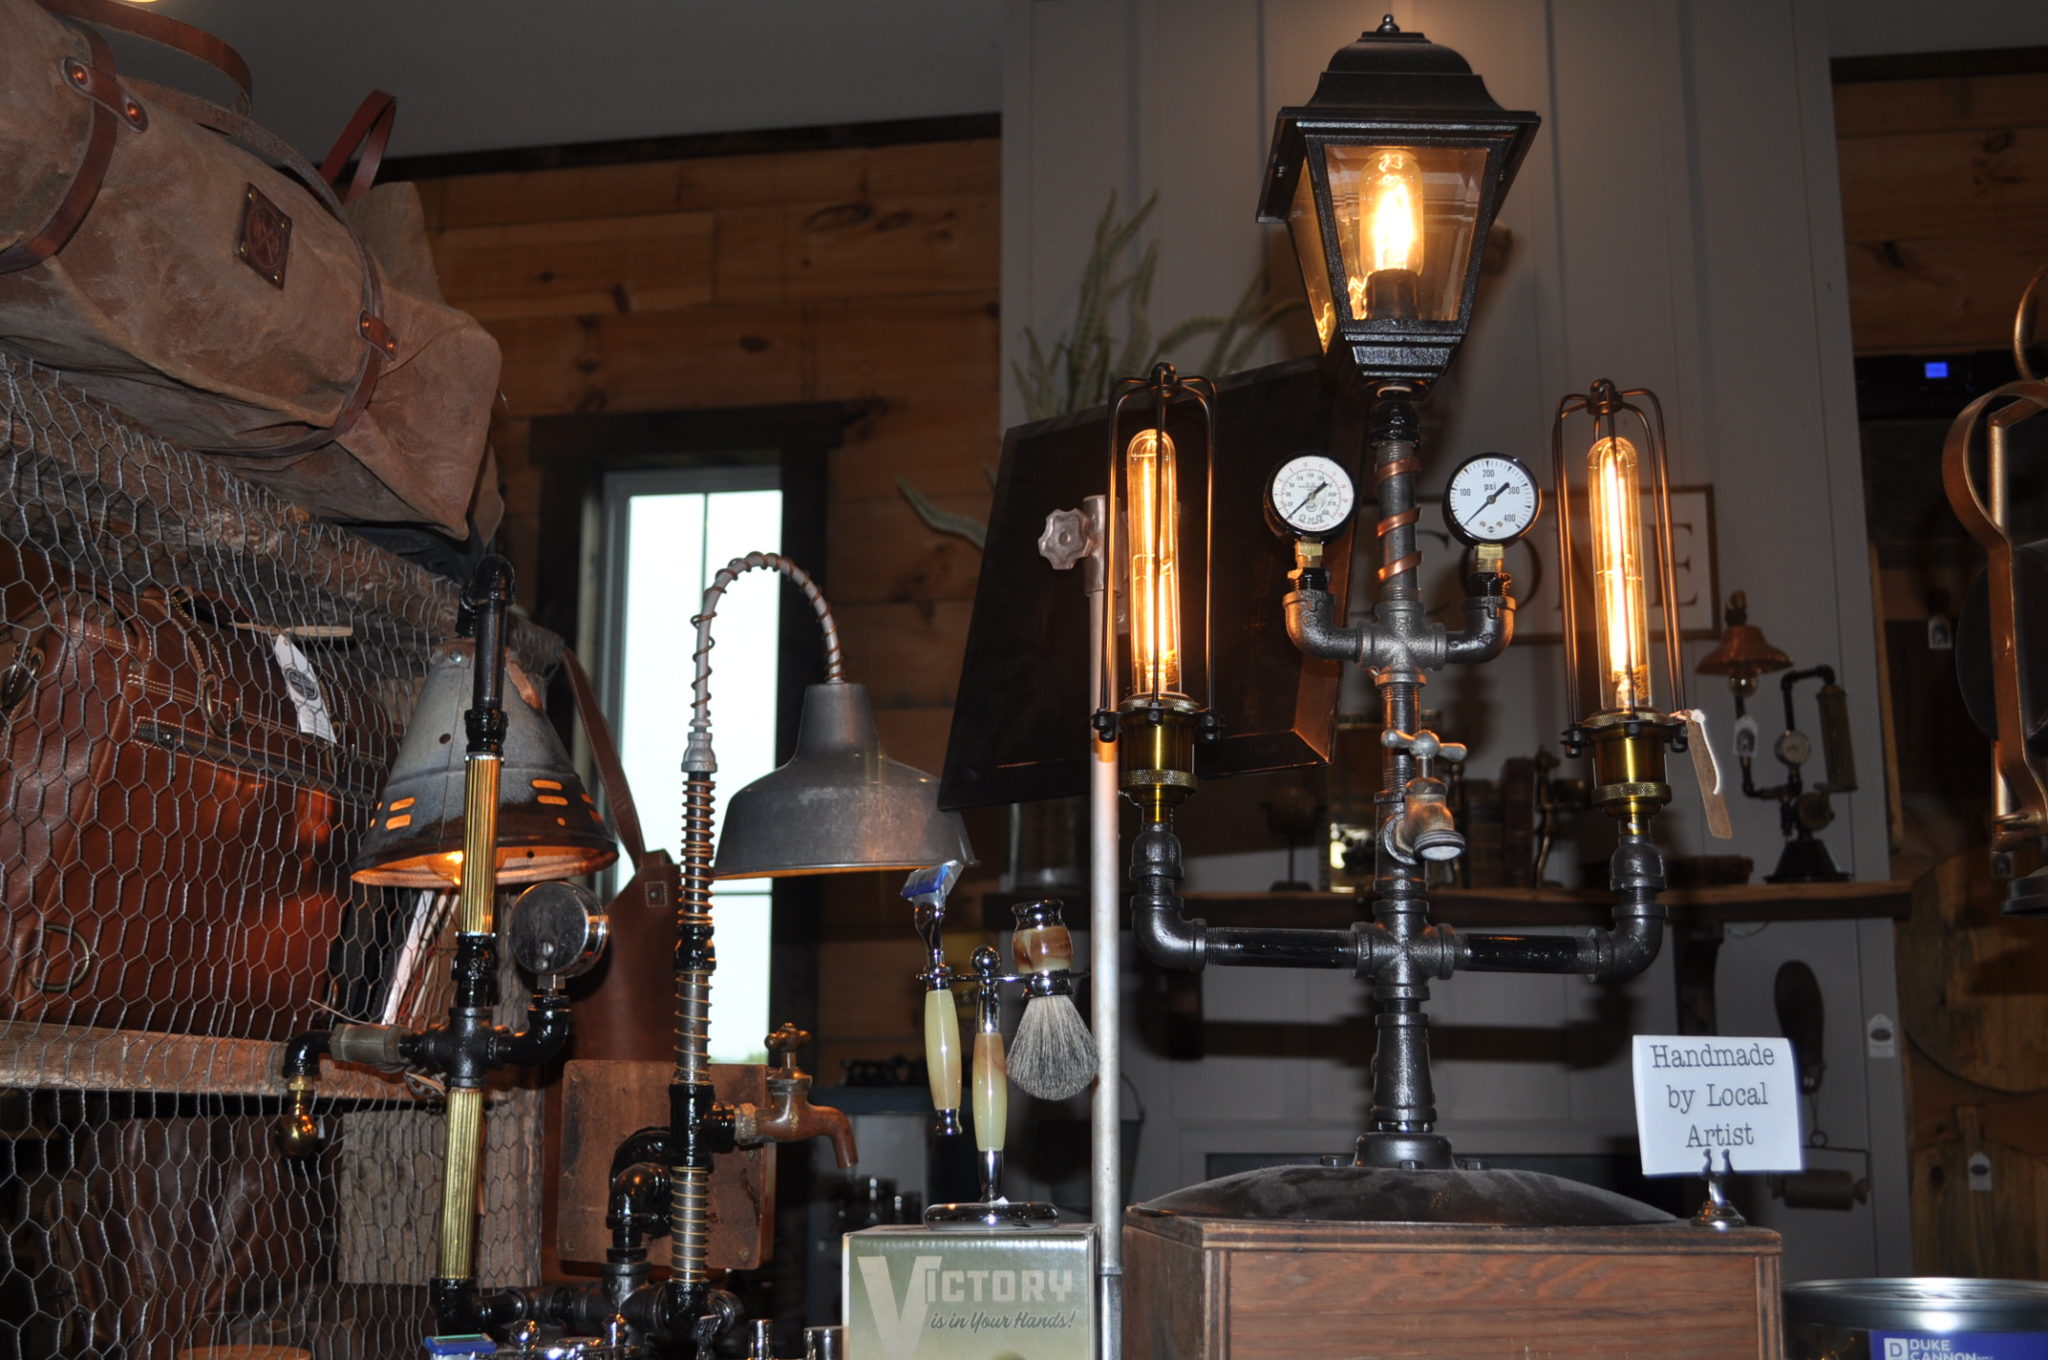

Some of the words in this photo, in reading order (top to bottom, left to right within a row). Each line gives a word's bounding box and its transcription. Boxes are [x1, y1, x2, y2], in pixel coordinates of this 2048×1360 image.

[1482, 469, 1495, 478] 200
[1484, 482, 1497, 491] psi
[1508, 487, 1520, 495] 300
[1460, 488, 1471, 497] 100
[1504, 514, 1516, 522] 400
[1650, 1043, 1775, 1068] Handmade
[1666, 1084, 1696, 1114] by
[1706, 1082, 1768, 1107] Local
[1685, 1122, 1754, 1148] Artist
[857, 1255, 1073, 1360] VICTORY
[930, 1312, 945, 1329] is
[948, 1312, 969, 1329] in
[969, 1311, 1014, 1334] Your
[1012, 1311, 1076, 1330] Hands!
[1909, 1338, 1951, 1352] DUKE
[1909, 1351, 1977, 1360] CANNON
